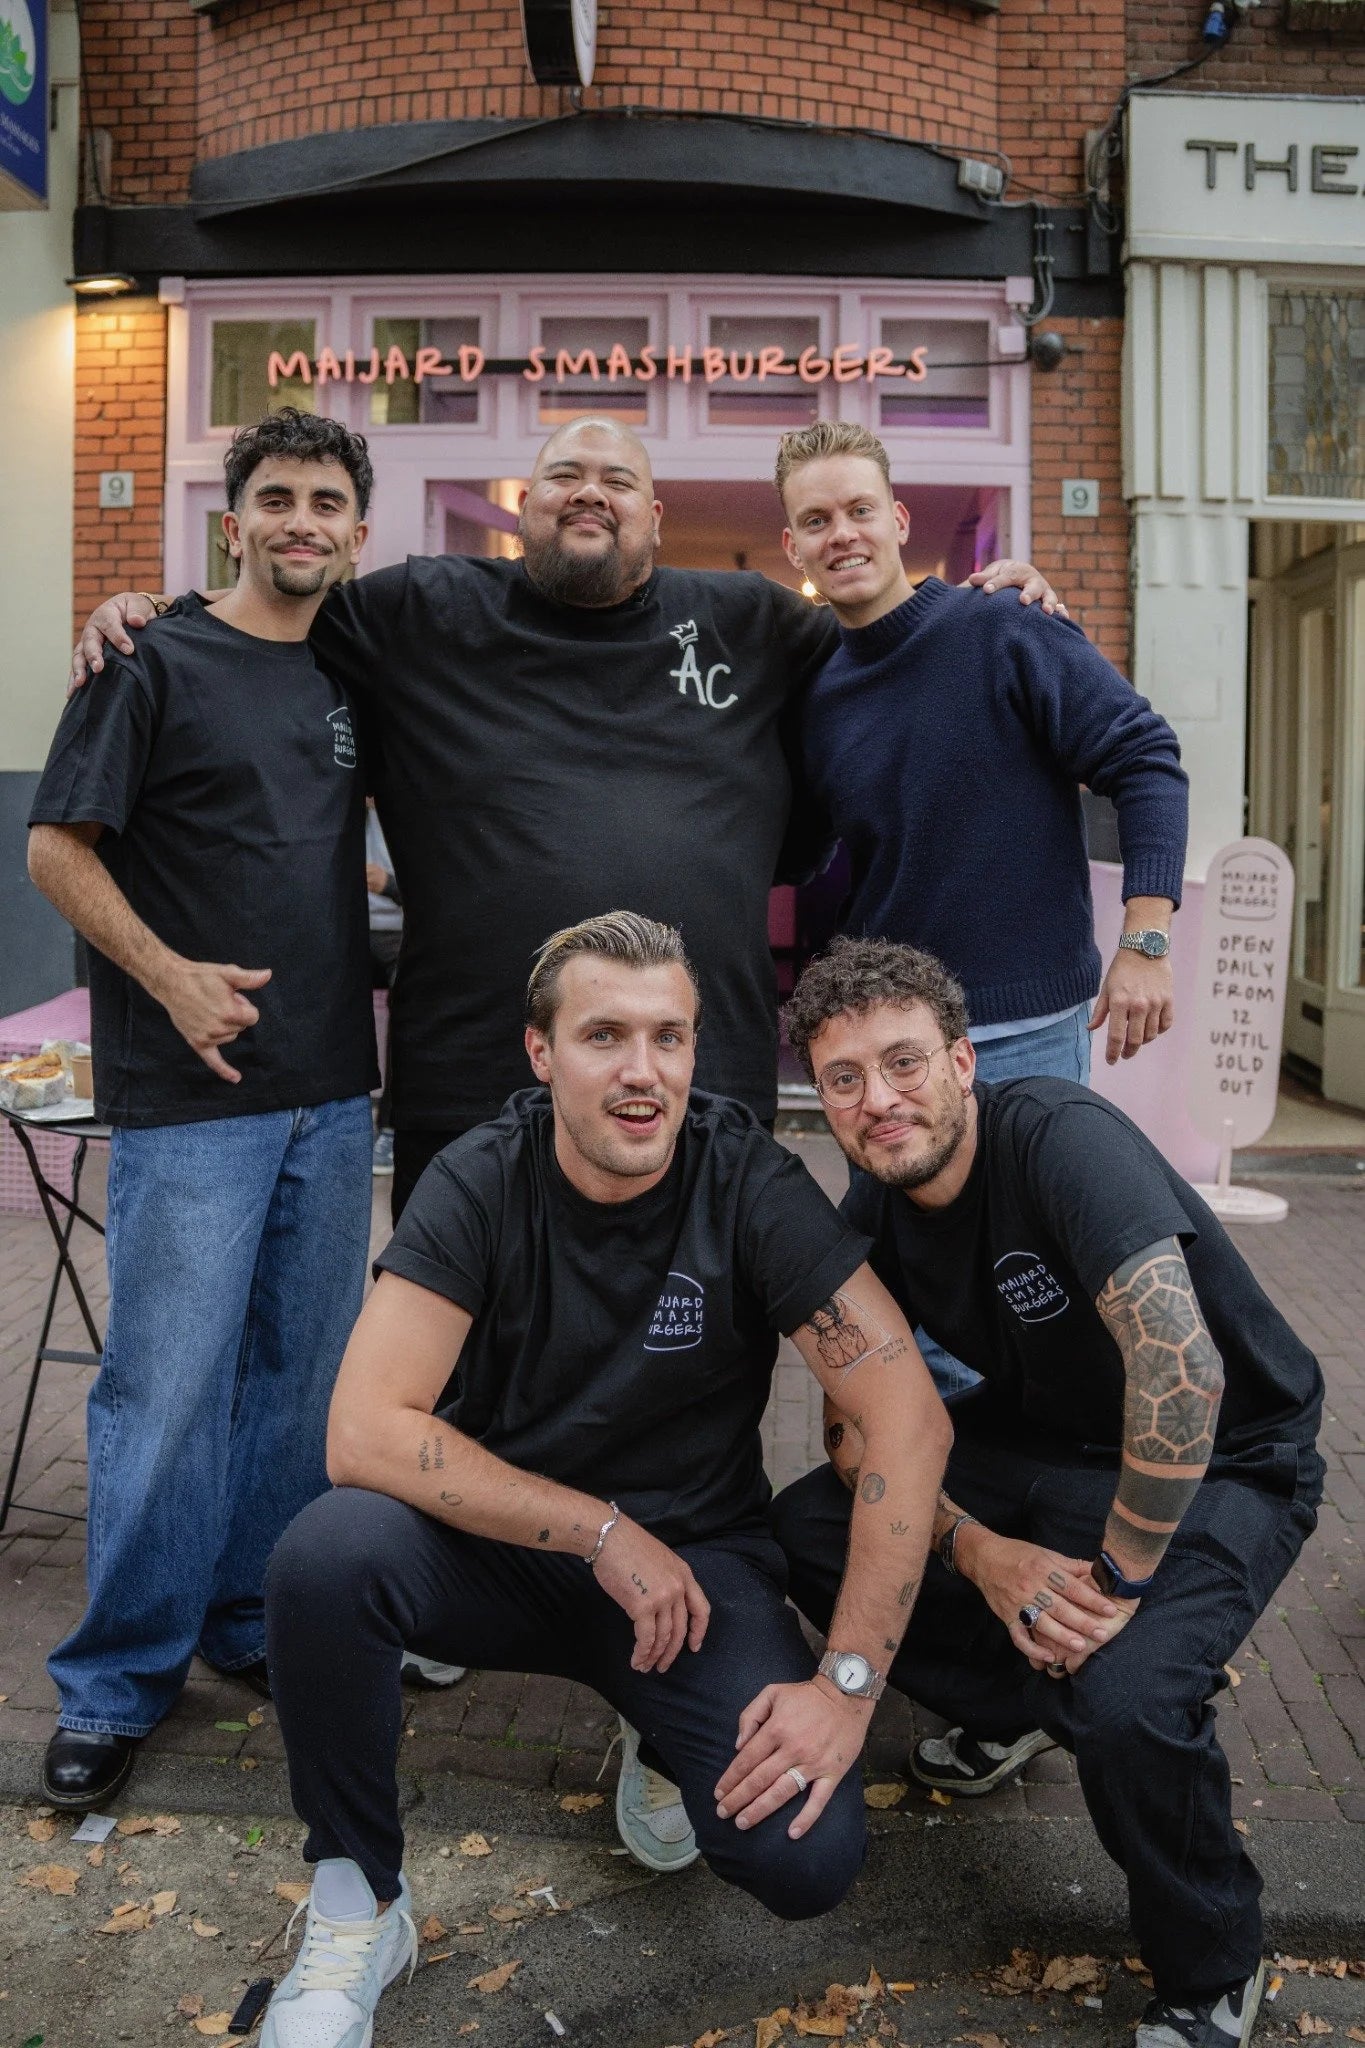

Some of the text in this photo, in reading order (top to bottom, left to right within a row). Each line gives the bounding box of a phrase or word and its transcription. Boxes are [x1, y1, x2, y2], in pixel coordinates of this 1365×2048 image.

[1185, 140, 1365, 196] THE
[267, 343, 929, 387] MAIJARD SMASH BURGERS
[108, 476, 125, 499] 9
[1071, 486, 1089, 510] 9
[1219, 934, 1275, 954] OPEN
[1216, 958, 1275, 978] DAILY
[1212, 981, 1275, 1003] FROM
[1232, 1009, 1251, 1025] 12
[1209, 1031, 1269, 1051] UNTIL
[1214, 1054, 1264, 1073] SOLD
[1219, 1078, 1255, 1096] OUT
[997, 1264, 1046, 1294] MAIJARD
[1005, 1274, 1057, 1304] SMASH
[1011, 1285, 1064, 1314] BURGERS
[653, 1309, 703, 1322] MASH
